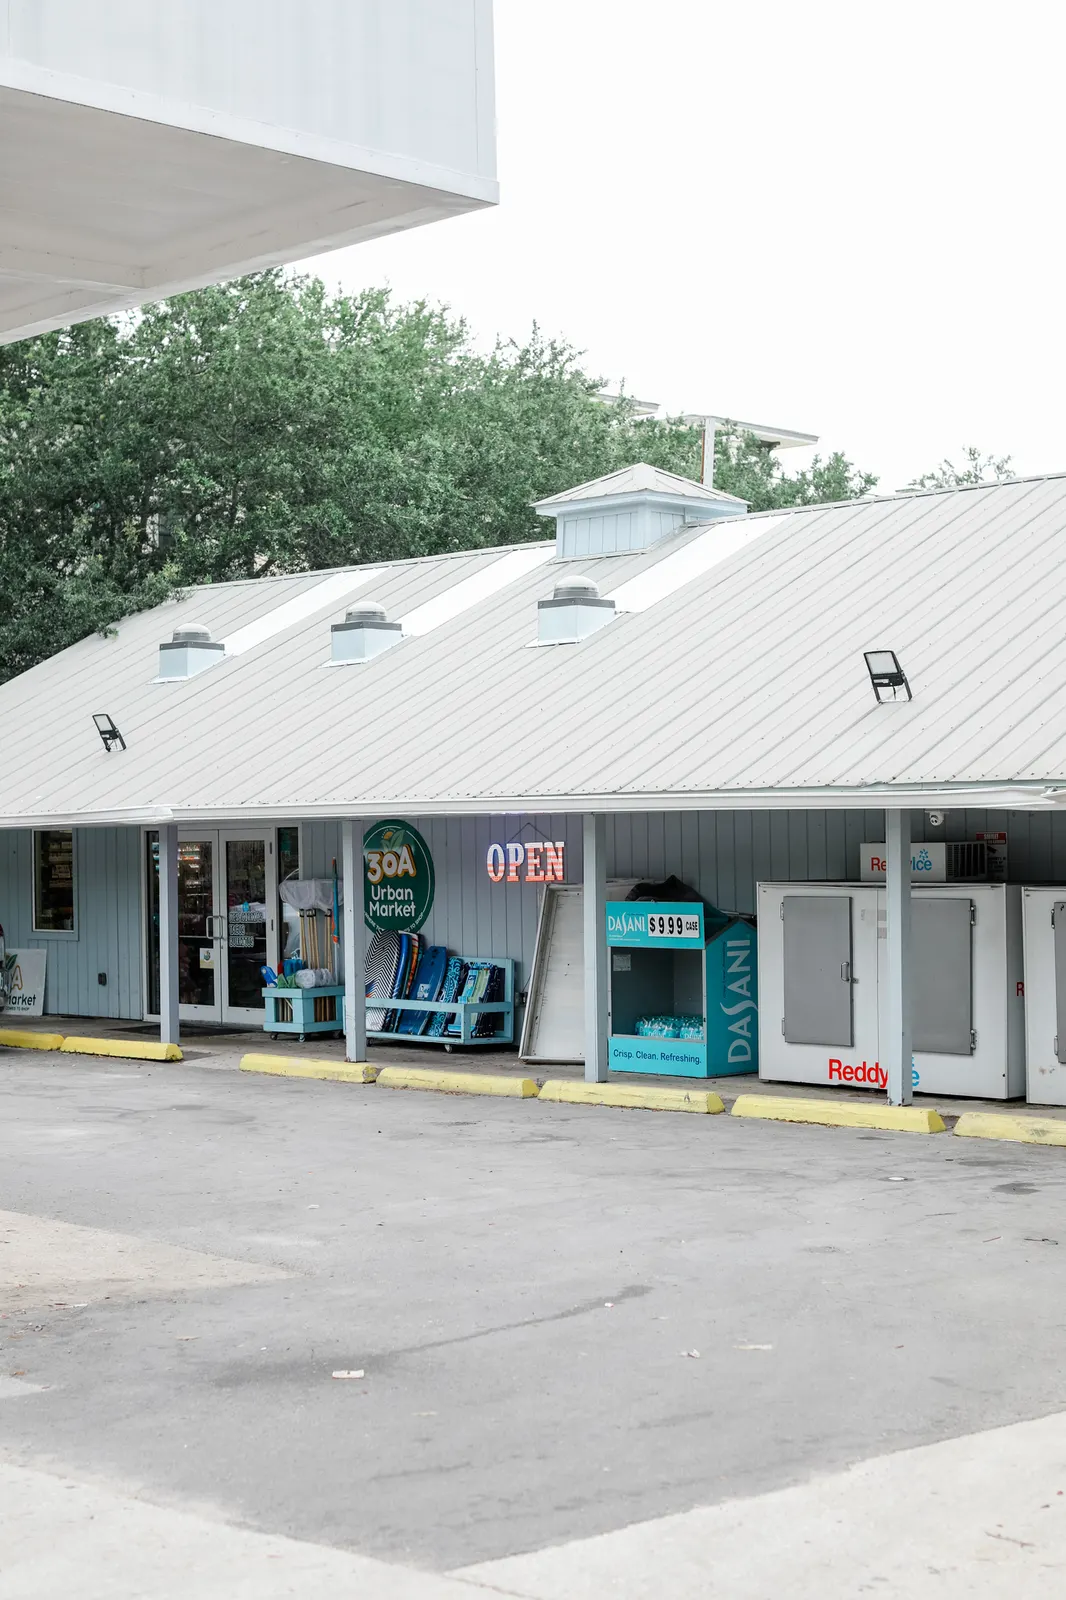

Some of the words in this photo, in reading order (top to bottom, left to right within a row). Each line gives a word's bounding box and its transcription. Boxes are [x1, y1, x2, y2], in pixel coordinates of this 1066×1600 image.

[367, 844, 417, 884] 30A
[487, 842, 565, 882] OPEN
[912, 857, 932, 871] Ice
[371, 885, 413, 901] Urban
[369, 901, 416, 917] Market
[608, 912, 646, 937] DASANI
[686, 921, 698, 931] CASE
[720, 939, 759, 1063] DASANI
[613, 1049, 634, 1059] Crisp.
[636, 1050, 659, 1060] Clean.
[660, 1052, 702, 1065] Refreshing.
[828, 1058, 888, 1089] Reddy
